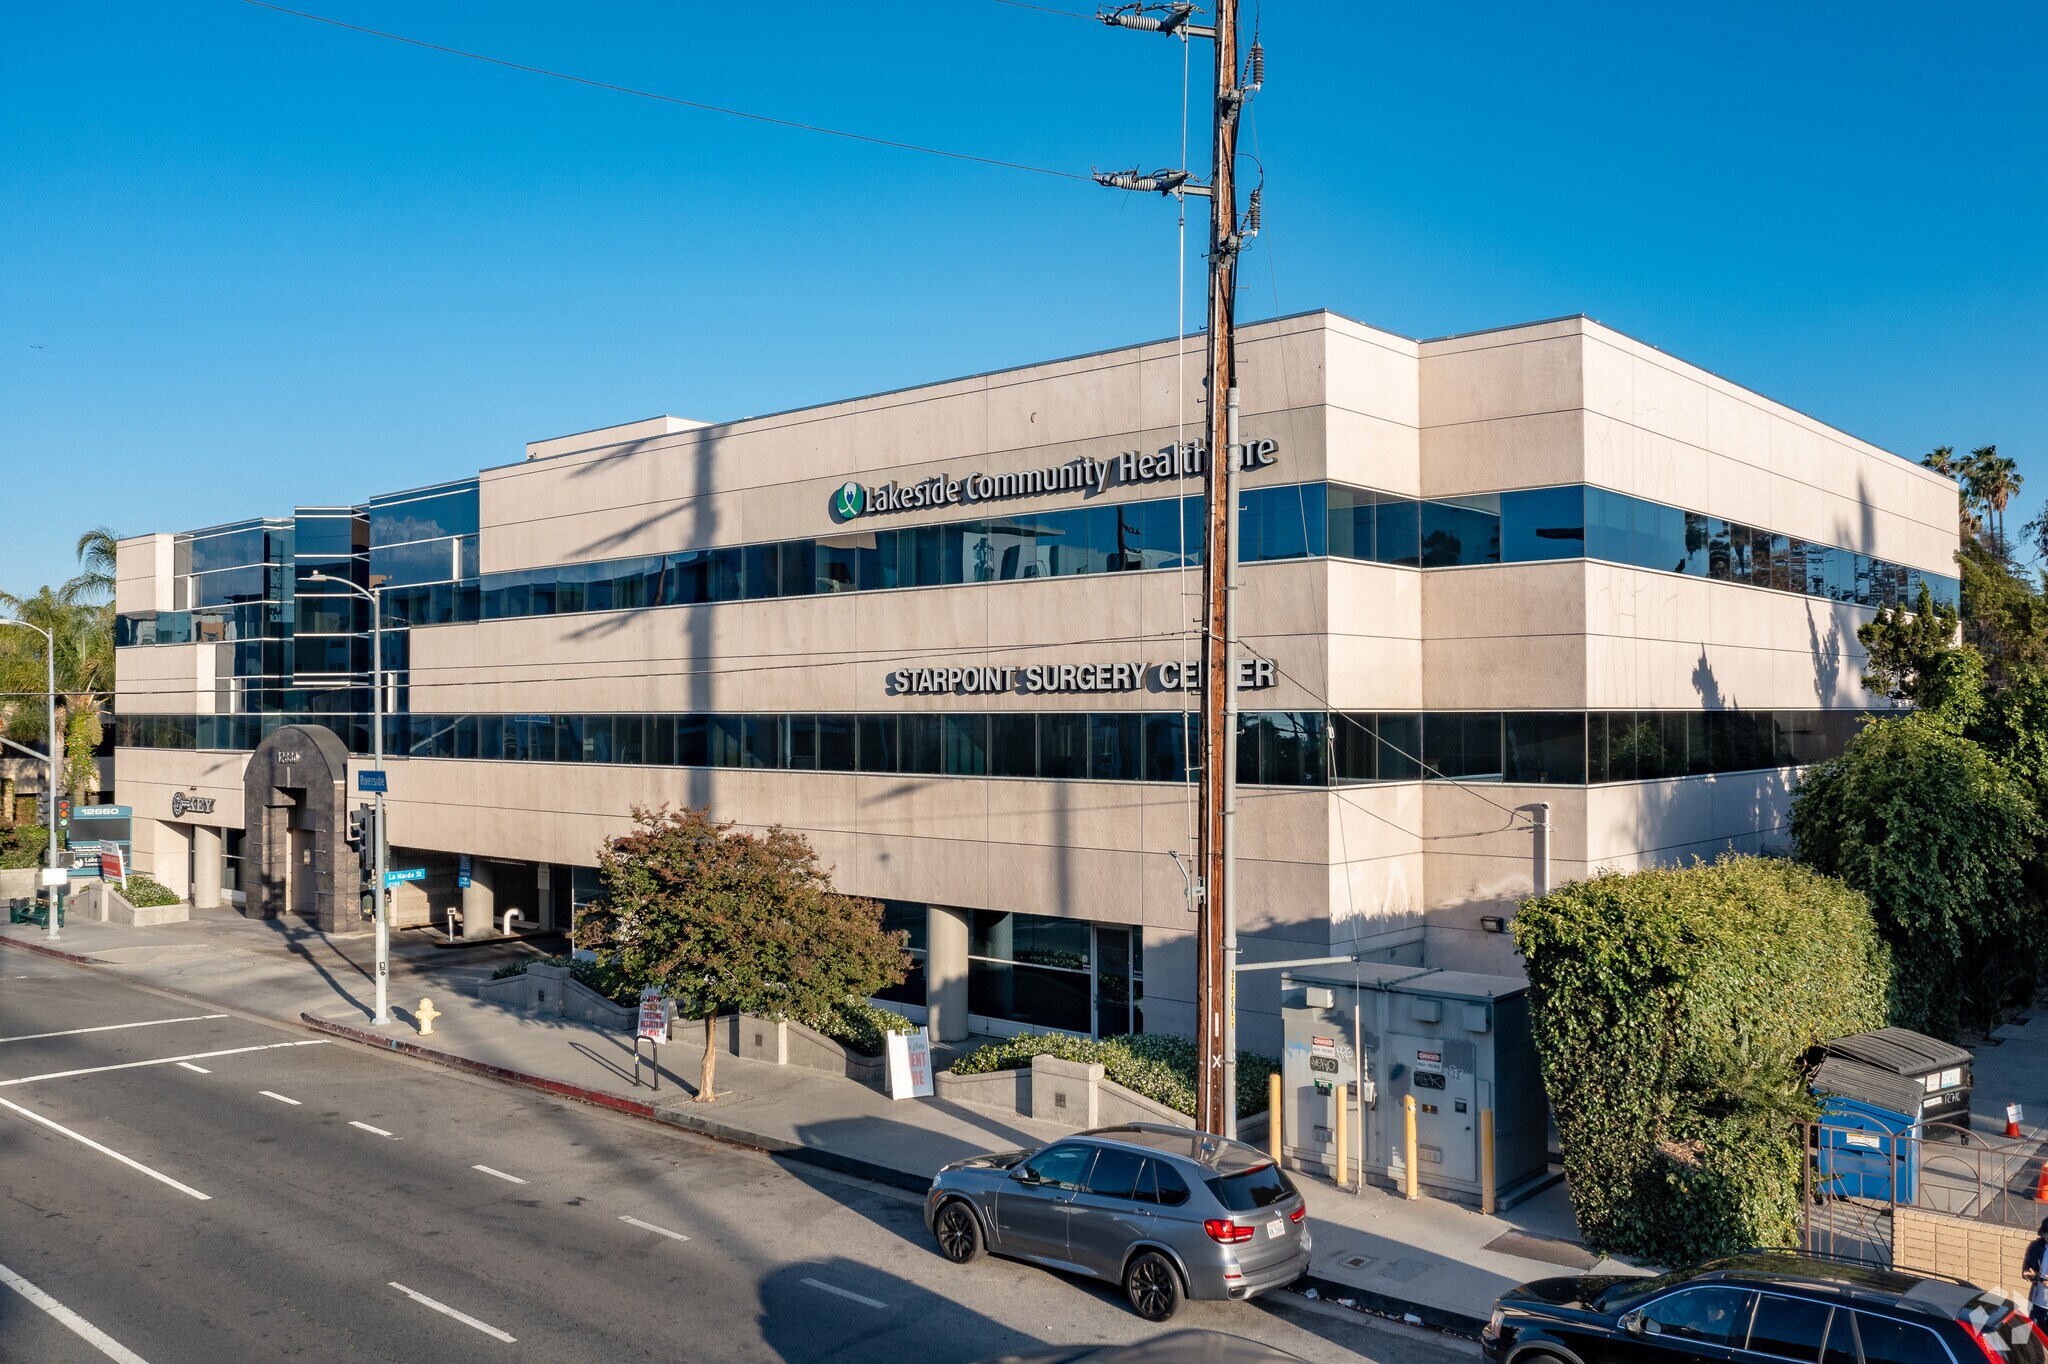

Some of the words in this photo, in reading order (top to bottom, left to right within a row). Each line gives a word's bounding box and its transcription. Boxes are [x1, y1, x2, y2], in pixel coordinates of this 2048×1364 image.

[866, 472, 962, 513] Lakeside
[966, 456, 1112, 500] Community
[1119, 437, 1279, 482] Healthre
[894, 664, 1020, 693] STARPOINT
[1026, 662, 1151, 692] SURGERY
[1159, 658, 1278, 690] CEER
[360, 774, 385, 787] Riverside
[388, 873, 396, 881] La
[416, 870, 422, 878] St
[644, 1012, 662, 1020] TESTING
[1314, 1038, 1334, 1047] DANGER
[1419, 1052, 1440, 1061] DANGER
